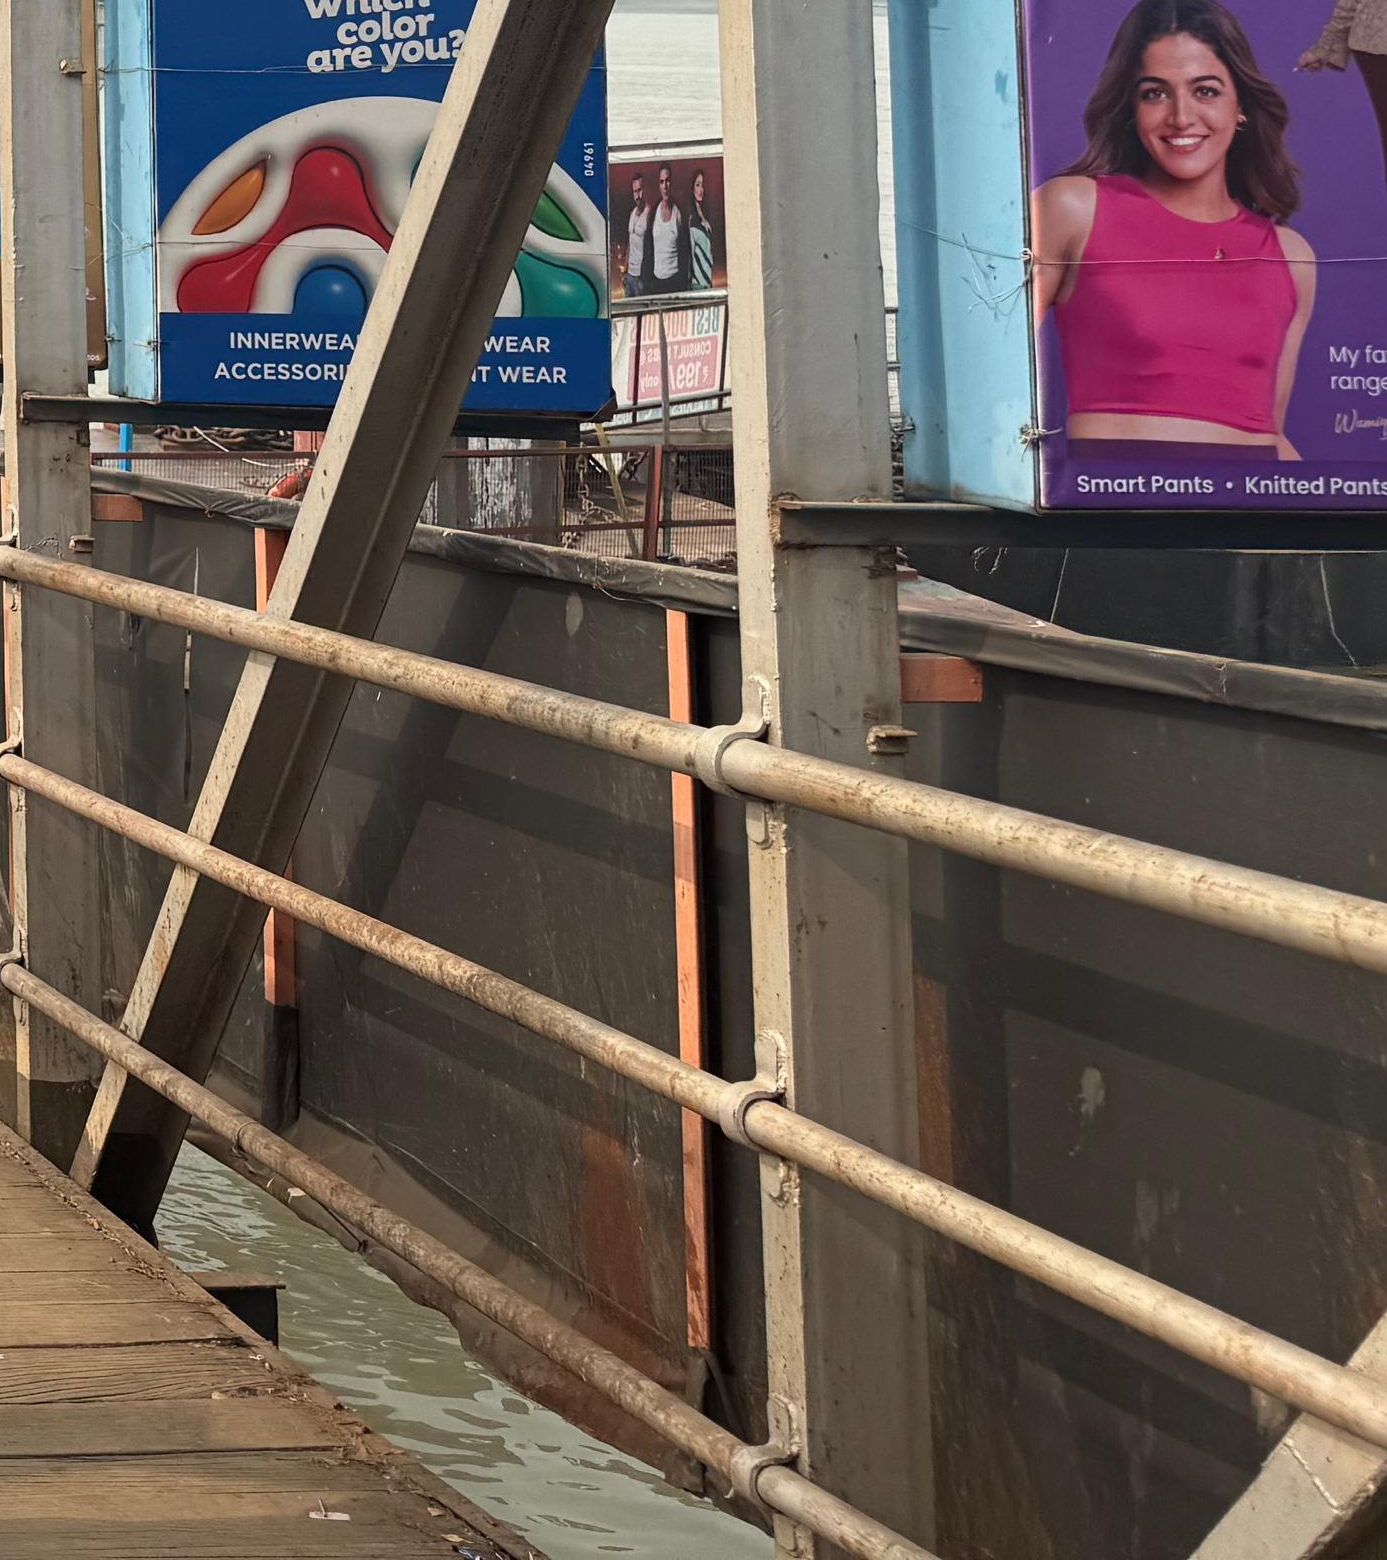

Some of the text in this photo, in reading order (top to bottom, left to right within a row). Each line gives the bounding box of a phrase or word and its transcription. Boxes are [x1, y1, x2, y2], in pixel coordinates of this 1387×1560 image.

[336, 11, 435, 45] color
[306, 29, 467, 74] are you?
[583, 142, 595, 177] 04961
[230, 332, 361, 351] INNERWEA
[1329, 345, 1360, 369] My
[214, 362, 568, 384] ACCESSORI WEAR
[1330, 374, 1387, 397] range
[1077, 475, 1387, 497] Smart Pants Knitted Pants
